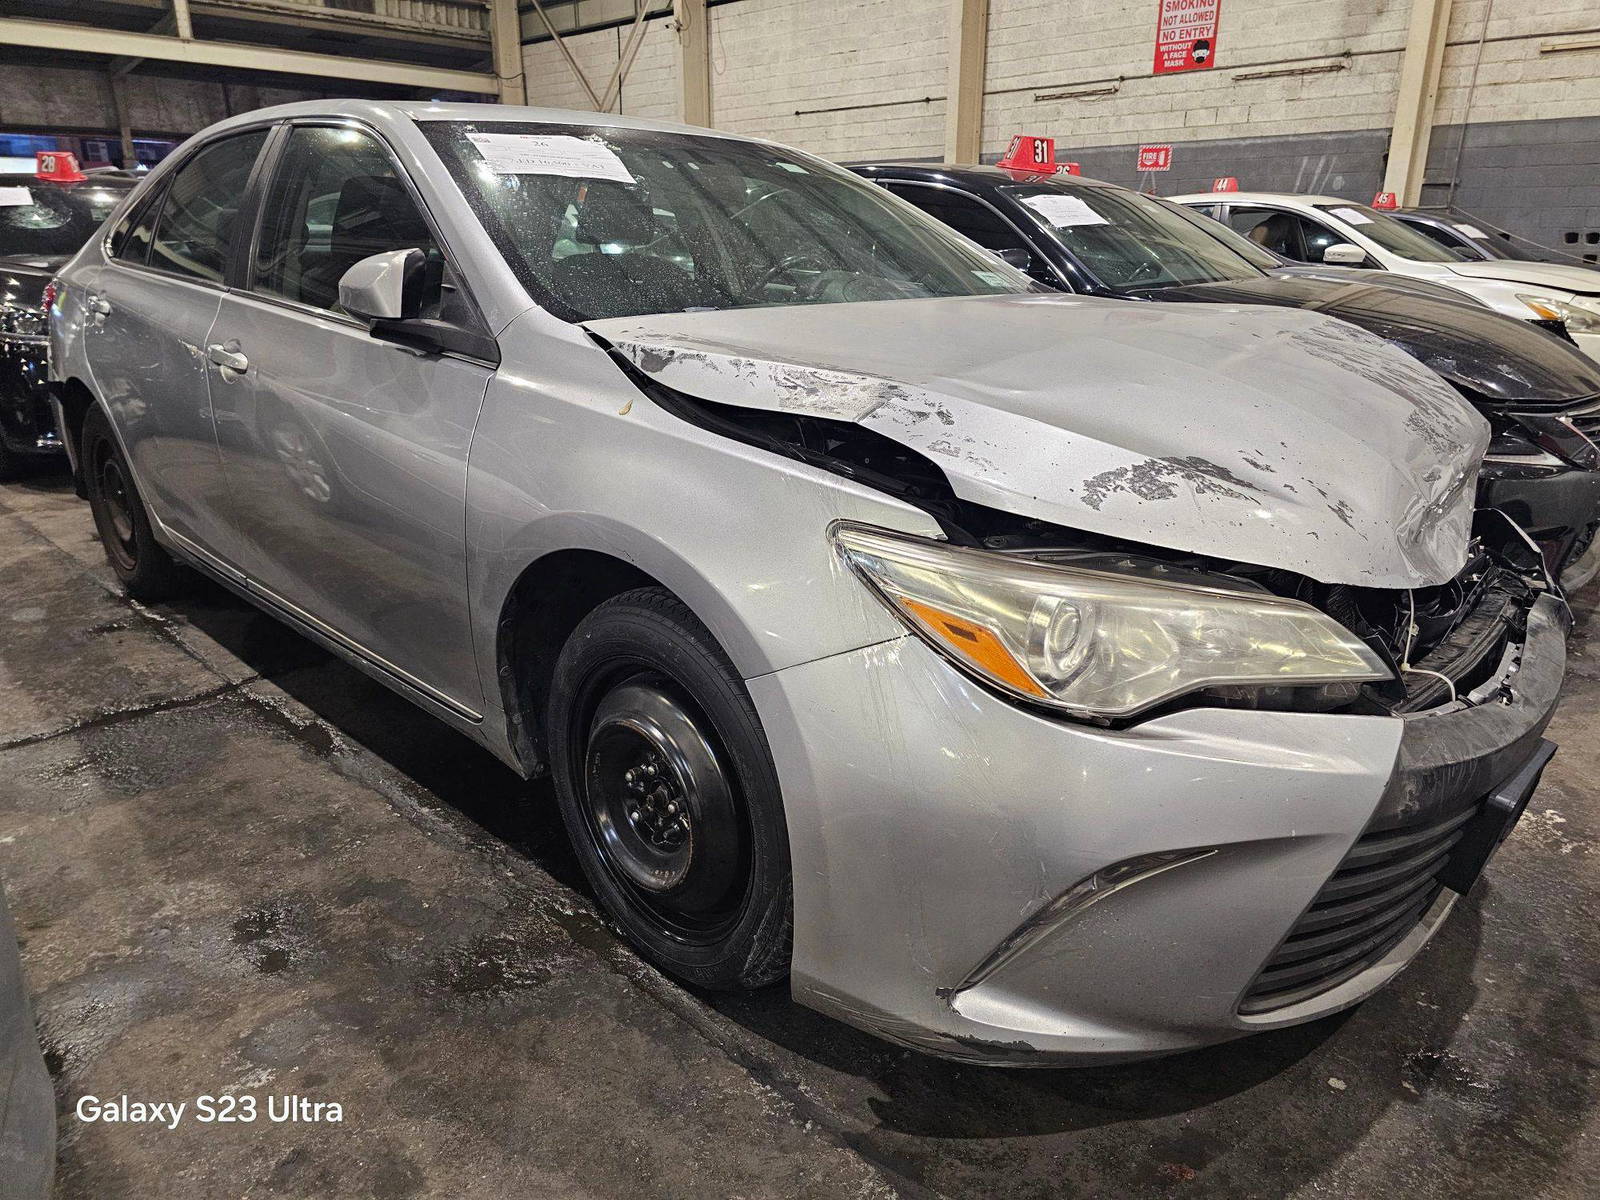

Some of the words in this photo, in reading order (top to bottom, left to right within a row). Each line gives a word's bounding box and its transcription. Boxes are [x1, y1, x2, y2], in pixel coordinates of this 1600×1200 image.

[1165, 0, 1215, 12] SMOKING
[1163, 15, 1178, 27] NOT
[1179, 10, 1215, 24] ALLOWED
[1162, 30, 1176, 41] NO
[1179, 26, 1212, 39] ENTRY
[1160, 42, 1192, 52] WITHOUT
[1163, 52, 1169, 60] A
[1170, 51, 1187, 59] FACE
[1164, 59, 1184, 67] MASK
[1034, 139, 1048, 164] 31
[1142, 151, 1158, 160] FIRE
[41, 155, 56, 173] 28
